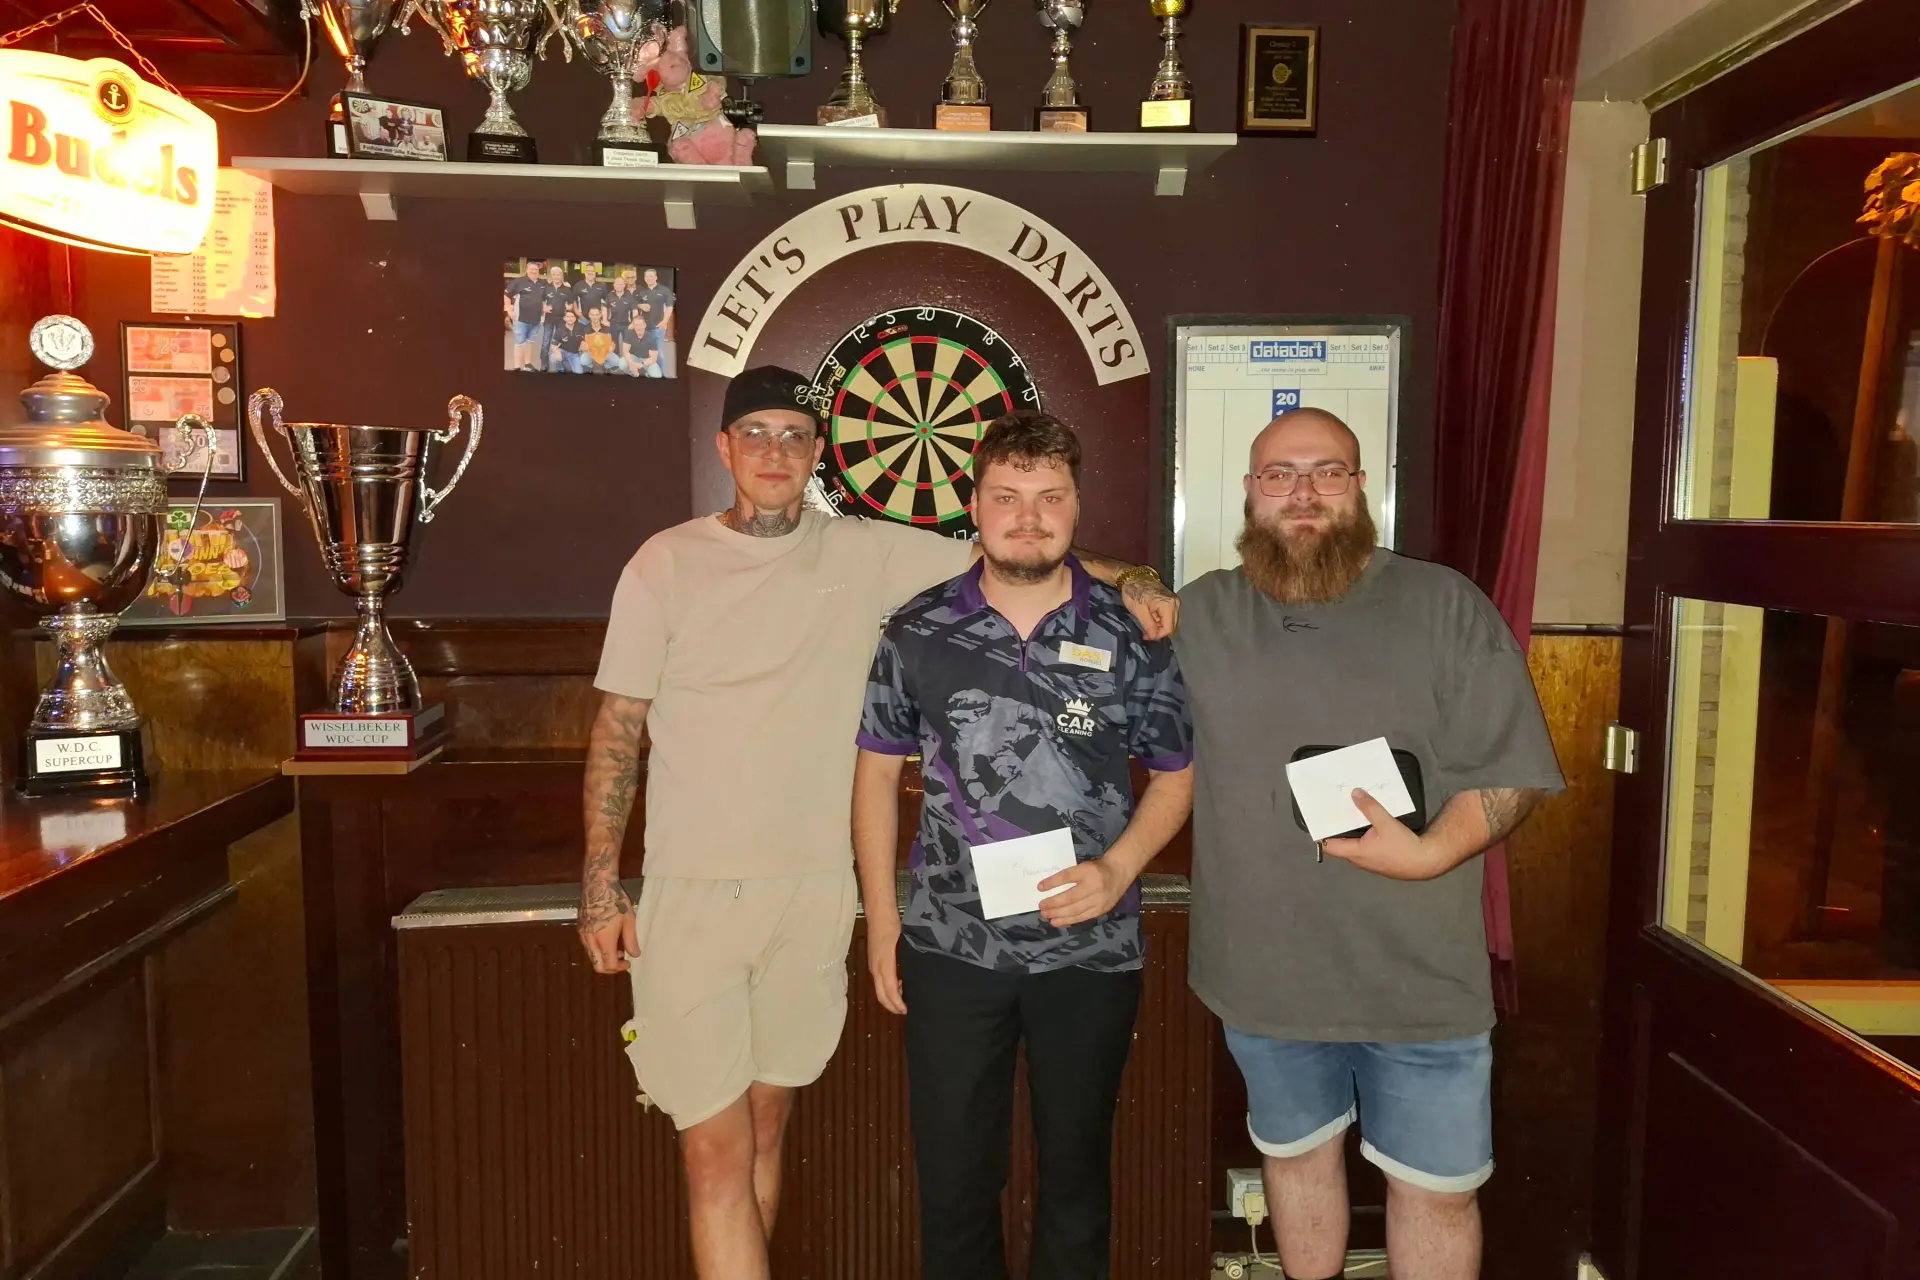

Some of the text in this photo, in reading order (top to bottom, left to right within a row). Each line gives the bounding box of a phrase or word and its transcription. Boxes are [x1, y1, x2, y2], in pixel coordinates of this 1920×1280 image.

[703, 194, 1136, 369] LET'S PLAY DARTS
[916, 307, 935, 321] 20
[982, 328, 998, 345] 18
[1252, 341, 1323, 358] datadart
[820, 365, 847, 419] BLADE
[1276, 392, 1297, 406] 20
[310, 722, 402, 732] WISSELBEKER
[1056, 713, 1095, 732] CAR
[57, 741, 102, 753] W.D.C.
[45, 754, 113, 768] SUPERCUP
